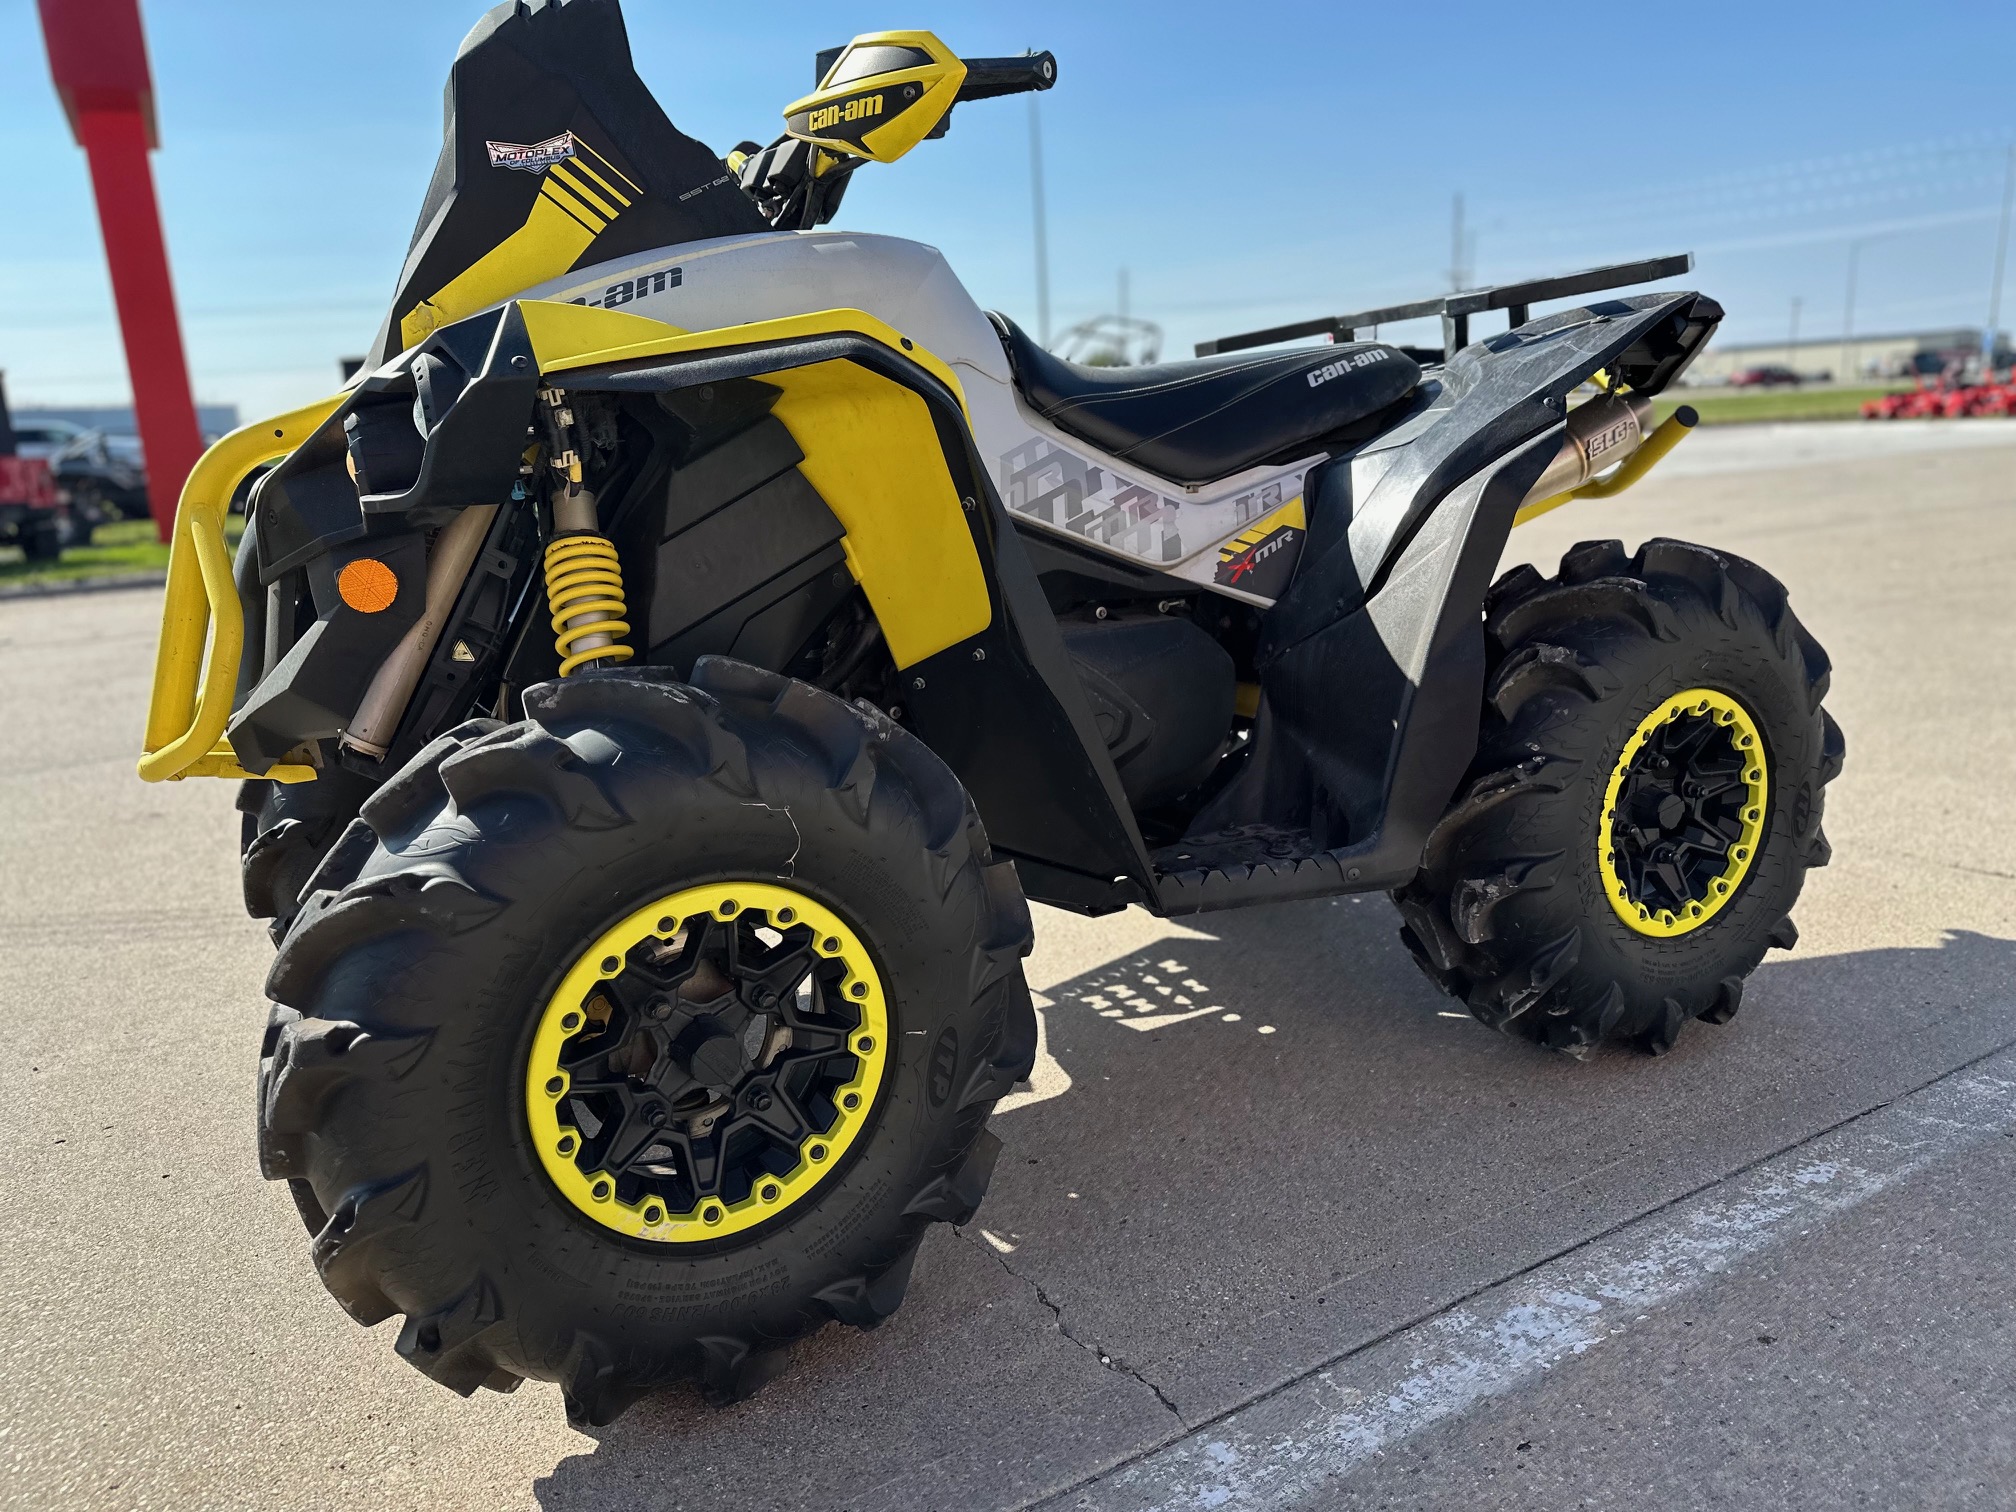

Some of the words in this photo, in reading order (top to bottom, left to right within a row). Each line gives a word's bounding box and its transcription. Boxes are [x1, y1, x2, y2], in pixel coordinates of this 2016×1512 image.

[808, 94, 884, 132] can-am
[495, 145, 571, 163] MOTOPLEX
[521, 155, 561, 164] COLUMBUS
[679, 182, 711, 202] SST
[1306, 349, 1389, 388] can-am
[933, 1034, 957, 1099] ITP
